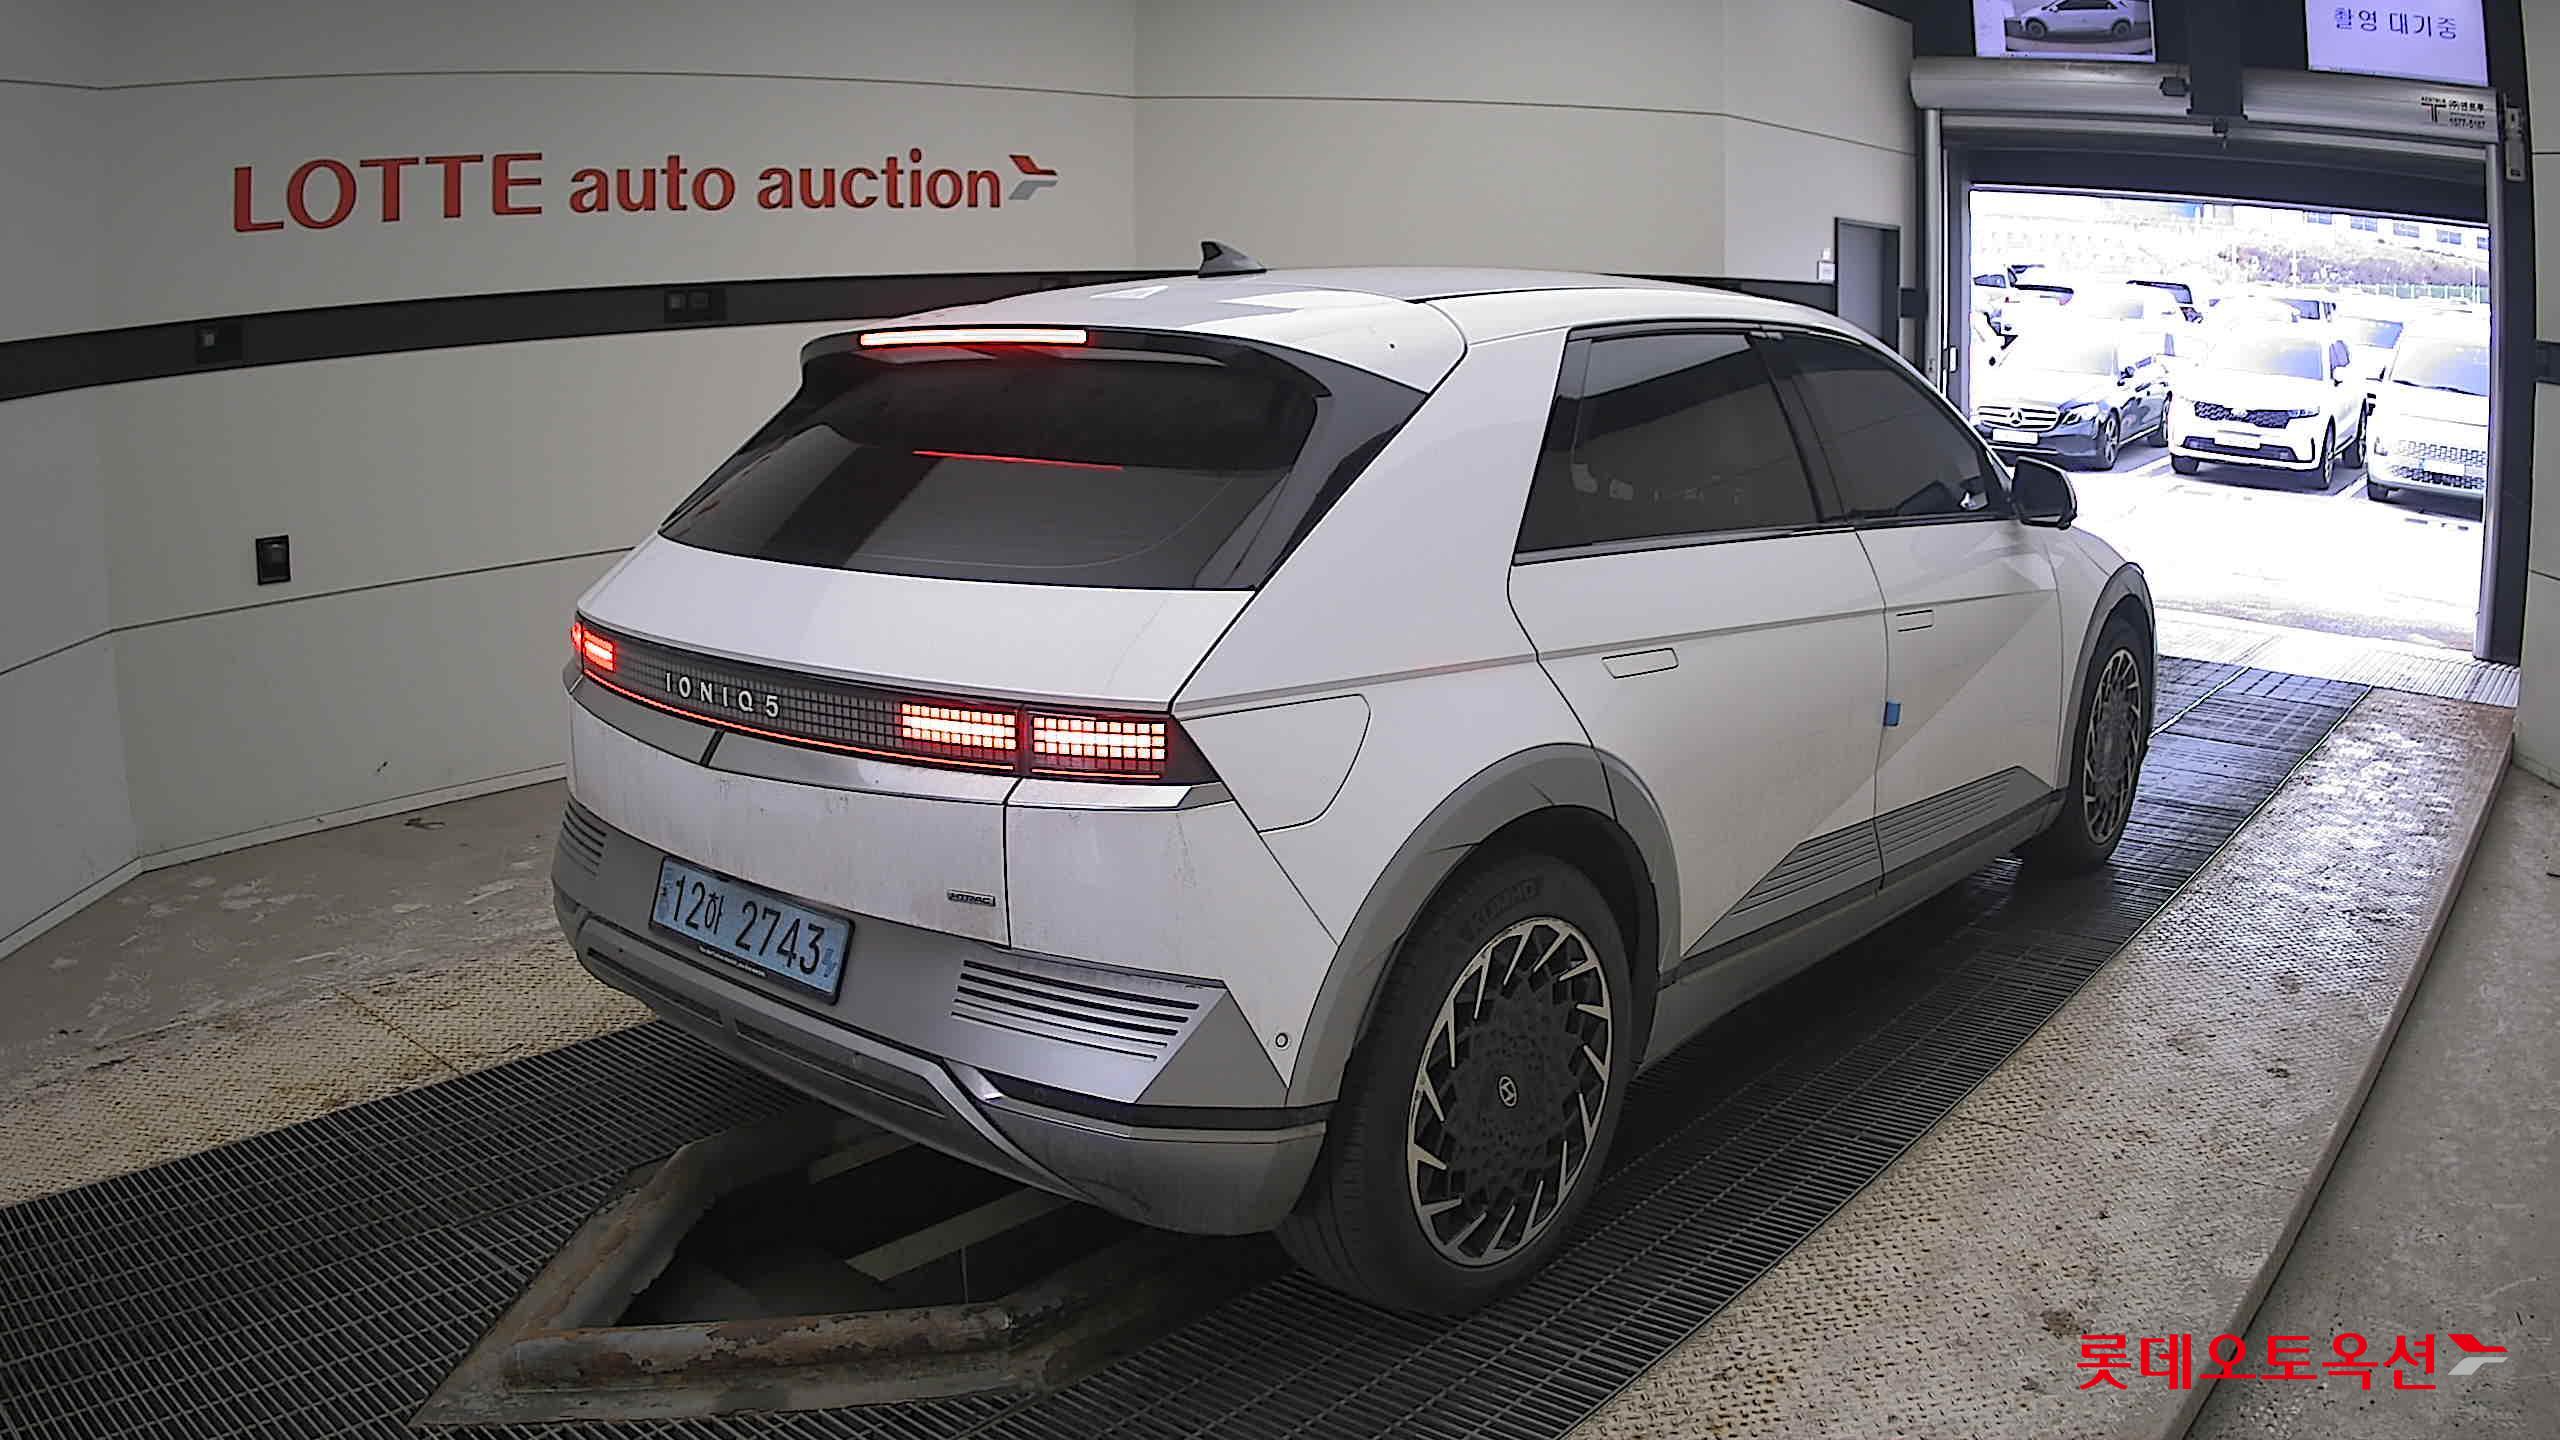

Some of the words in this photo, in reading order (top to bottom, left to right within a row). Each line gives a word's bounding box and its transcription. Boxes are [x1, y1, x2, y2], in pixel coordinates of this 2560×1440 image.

[2388, 13, 2457, 40] 대기중
[234, 151, 543, 232] LOTTE
[568, 154, 736, 213] auto
[757, 147, 1002, 210] auction
[664, 672, 754, 713] IONIQ
[765, 694, 780, 718] 5
[673, 874, 726, 935] 12하
[734, 900, 826, 975] 2743
